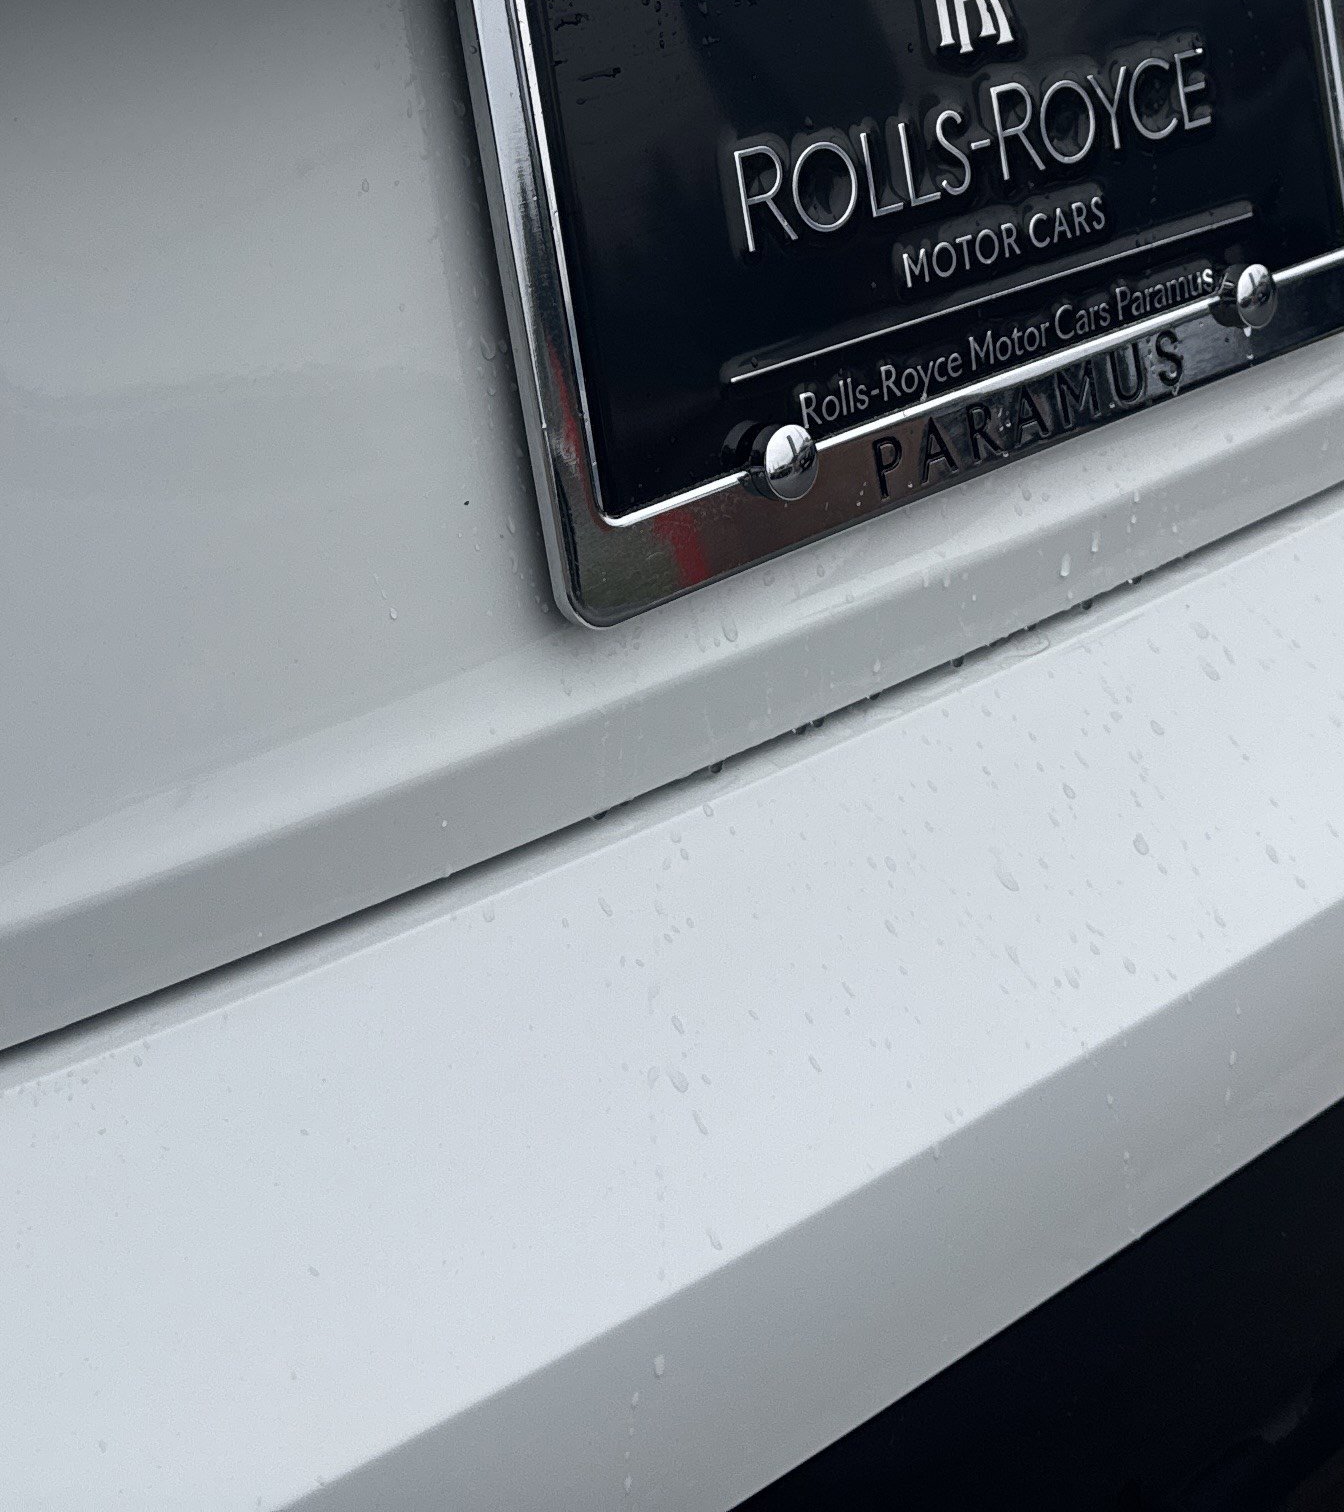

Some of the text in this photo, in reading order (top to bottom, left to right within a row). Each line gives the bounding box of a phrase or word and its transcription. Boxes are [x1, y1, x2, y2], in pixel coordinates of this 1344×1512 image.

[733, 48, 1212, 253] ROLLS-ROYCE
[902, 196, 1107, 288] MOTOR CARS
[799, 267, 1214, 429] Rolls-Royce Motor Cars Paramus
[871, 329, 1185, 500] PARAMUS
